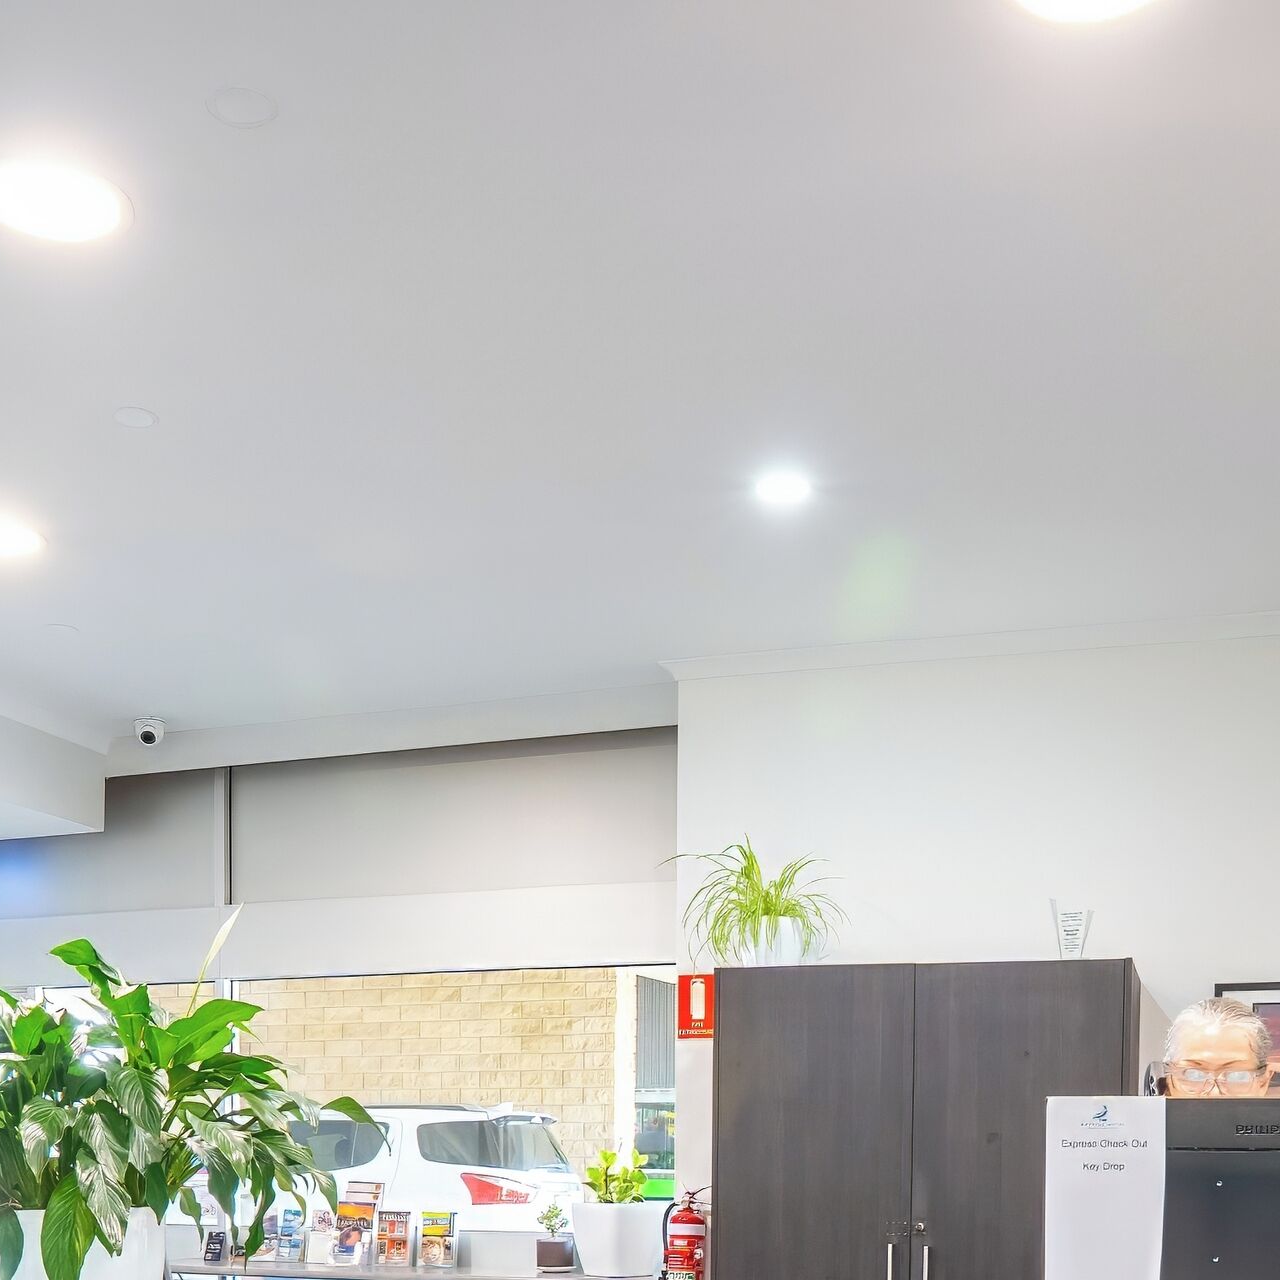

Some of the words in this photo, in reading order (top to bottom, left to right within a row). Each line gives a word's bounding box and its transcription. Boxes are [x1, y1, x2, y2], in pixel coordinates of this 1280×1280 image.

[1061, 1139, 1098, 1149] Express
[1099, 1139, 1128, 1149] Check
[1131, 1139, 1148, 1149] Out
[1082, 1162, 1100, 1172] Key
[1102, 1162, 1125, 1172] Drop
